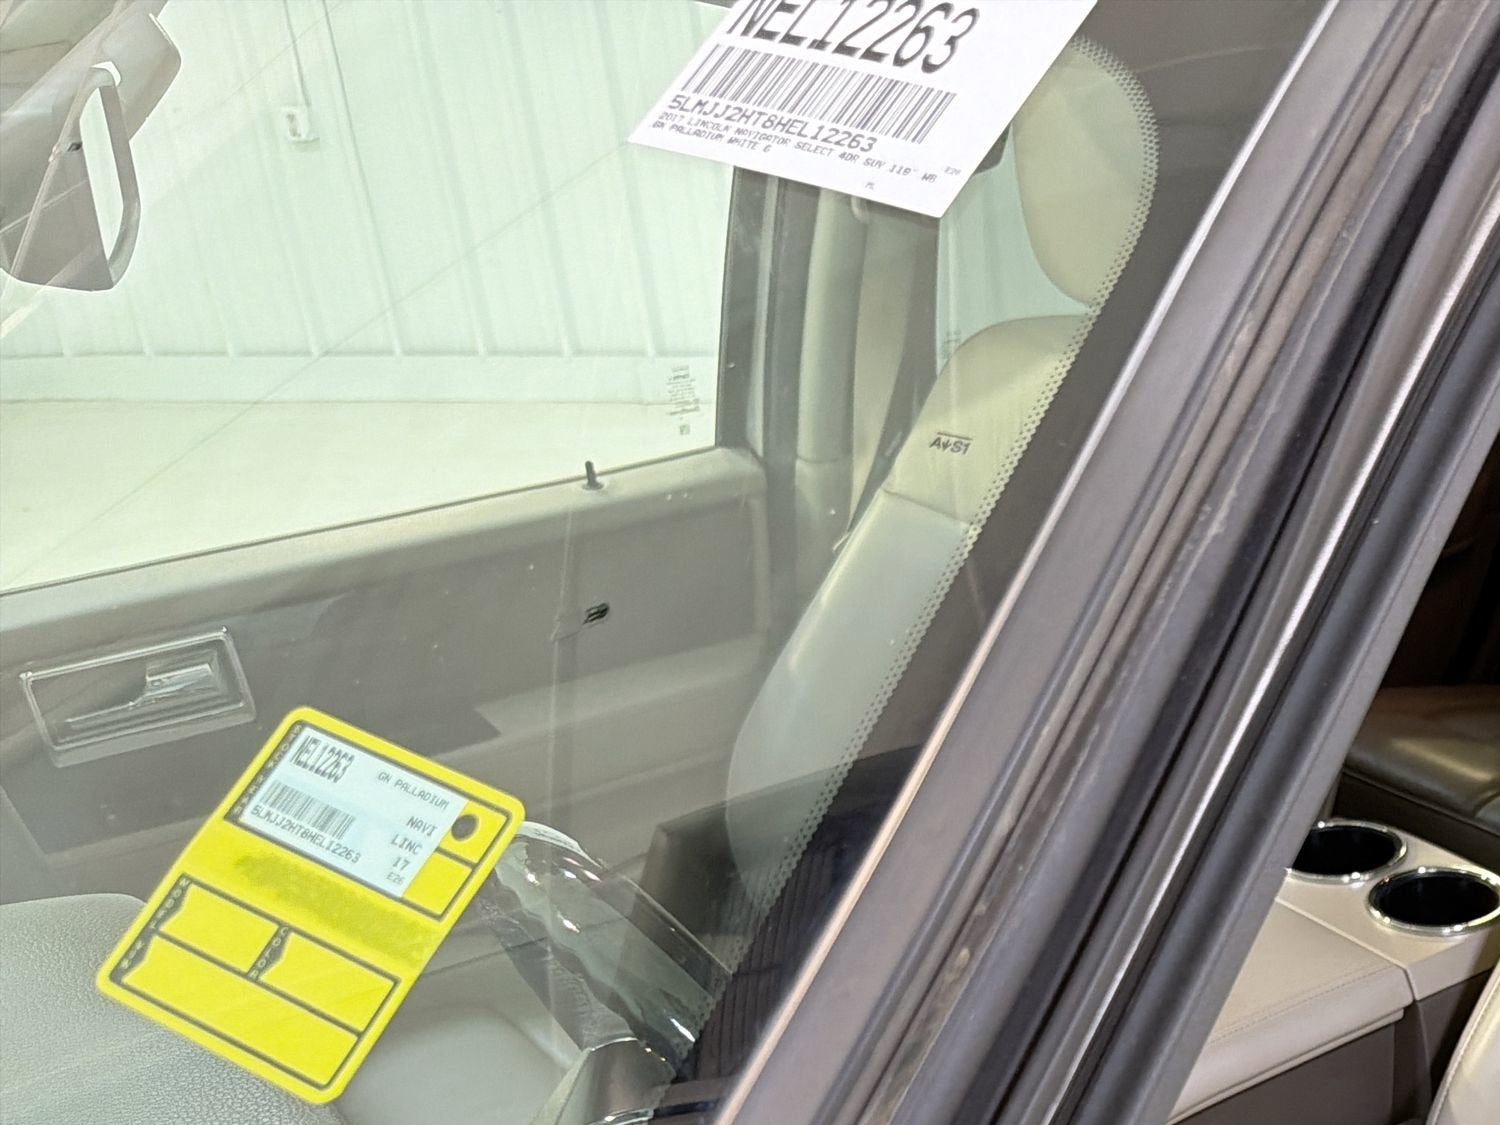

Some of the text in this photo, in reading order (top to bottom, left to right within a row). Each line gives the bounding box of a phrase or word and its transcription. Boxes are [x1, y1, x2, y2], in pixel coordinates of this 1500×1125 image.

[726, 0, 980, 74] NEL12263
[667, 94, 878, 153] 5LMJJ2HT8HEL12263
[668, 123, 726, 142] PALLADIUM
[726, 136, 760, 151] WHITE
[734, 127, 791, 146] NAVIGATOR
[794, 142, 836, 157] SELECT
[838, 151, 861, 164] 4DR
[862, 157, 888, 169] SUV
[290, 735, 355, 783] NEL12263
[377, 771, 451, 812] GN PALLADIUM
[250, 804, 363, 864] 5LMJJ2HT8HEL12263
[390, 833, 424, 856] LINC
[406, 815, 439, 837] NAVI
[393, 855, 411, 872] 17
[248, 926, 289, 980] COLOR
